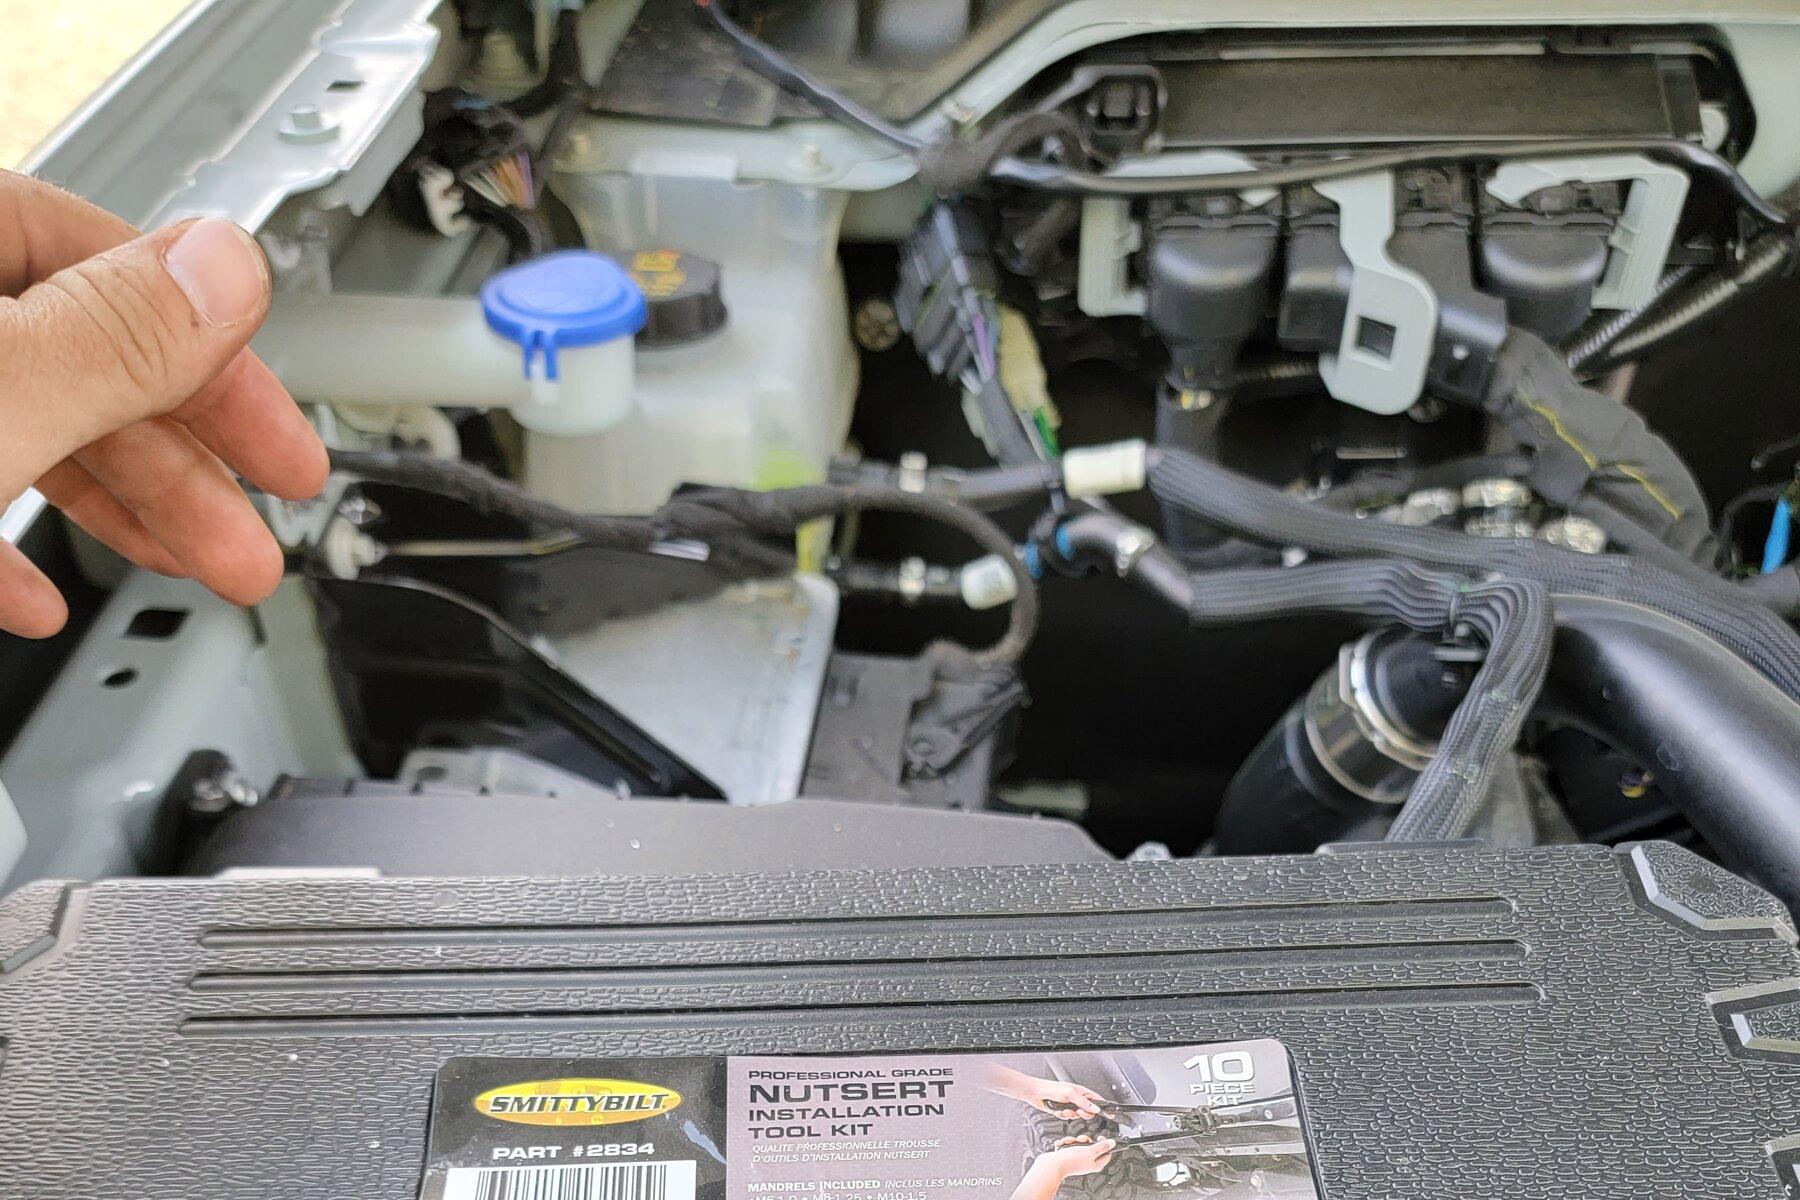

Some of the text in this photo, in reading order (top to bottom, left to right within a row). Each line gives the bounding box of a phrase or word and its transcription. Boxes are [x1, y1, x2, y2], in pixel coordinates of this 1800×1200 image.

[749, 1068, 954, 1081] PROFESSIONAL GRADE
[1182, 1051, 1255, 1082] 10
[750, 1080, 954, 1104] NUTSERT
[1190, 1083, 1255, 1095] PIECE
[490, 1093, 669, 1113] SMITTYBILT
[1207, 1095, 1242, 1107] KIT
[749, 1104, 945, 1121] INSTALLATION
[748, 1123, 874, 1139] TOOL KIT
[492, 1143, 655, 1160] PART #2834
[752, 1139, 941, 1154] QUALITE PROFESSIONNELLE TROUSSE
[884, 1150, 931, 1160] NUTSERT
[747, 1177, 1003, 1193] MANDRELS INCLUDED INCLUS LES MANDRINS
